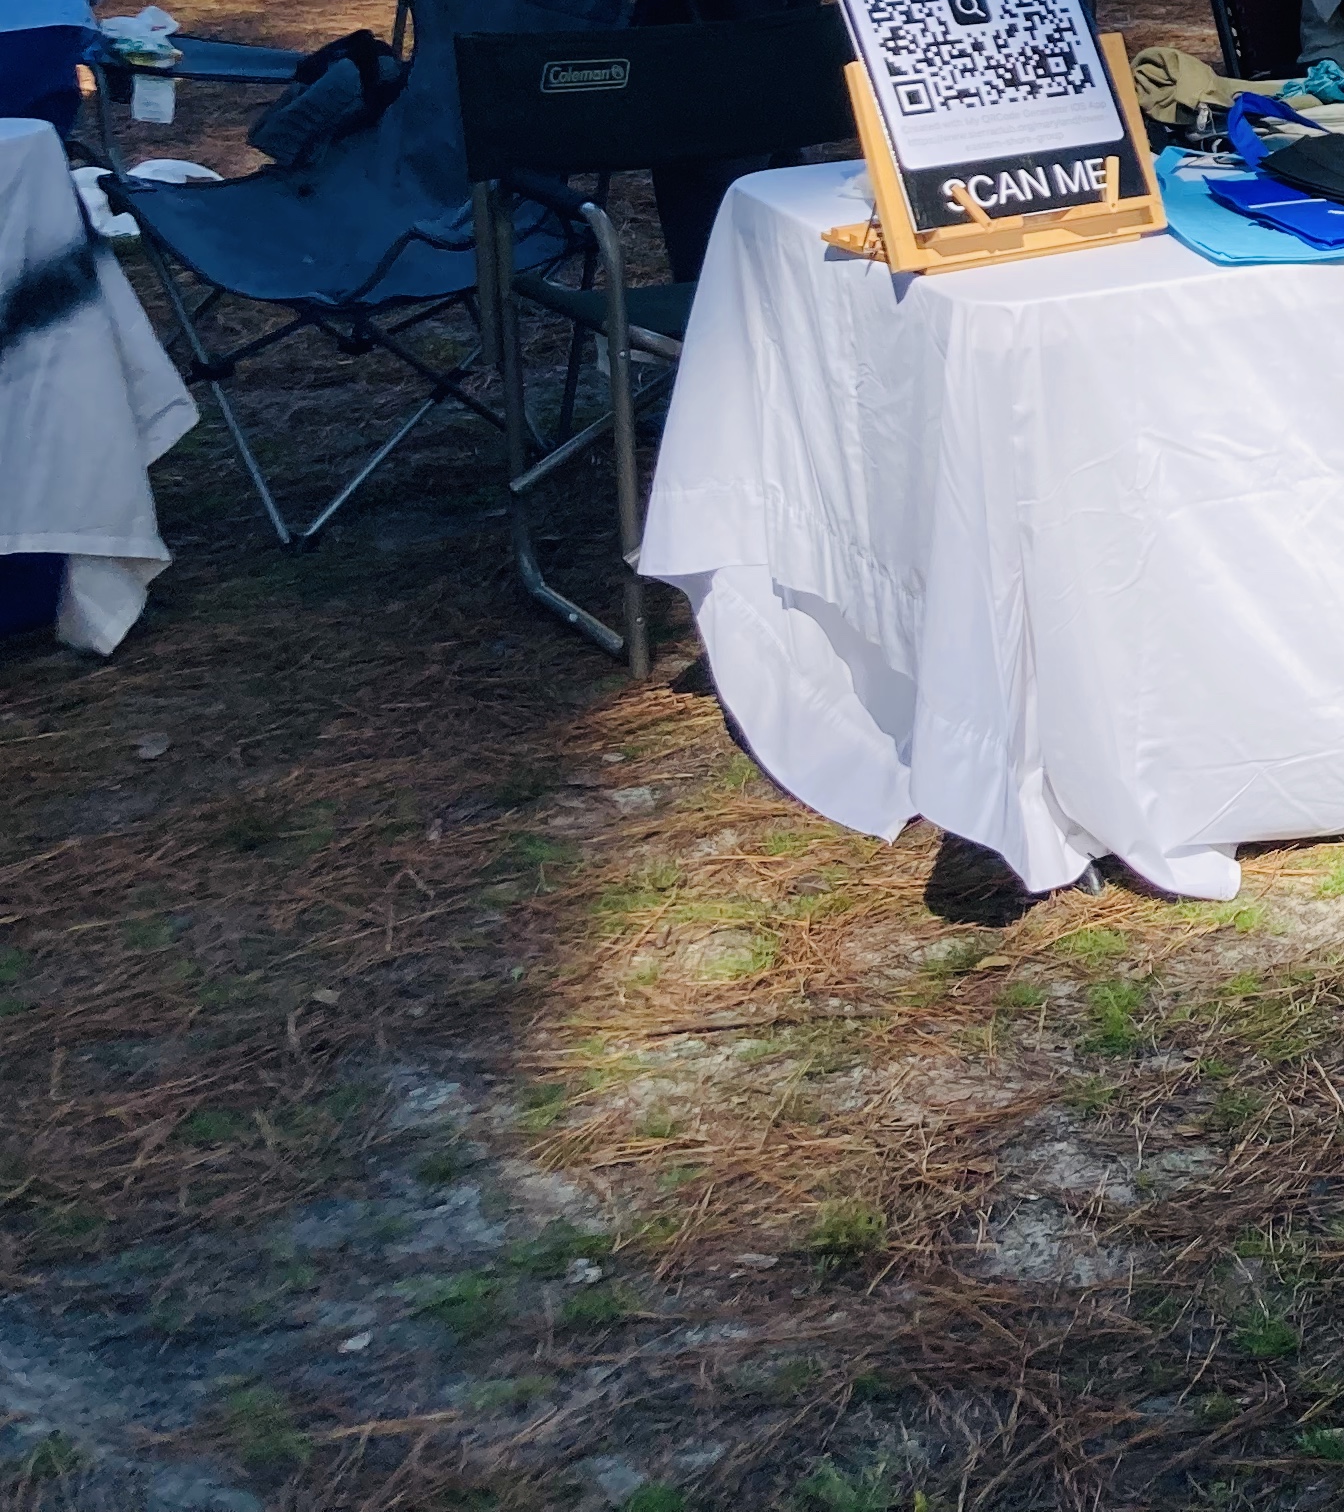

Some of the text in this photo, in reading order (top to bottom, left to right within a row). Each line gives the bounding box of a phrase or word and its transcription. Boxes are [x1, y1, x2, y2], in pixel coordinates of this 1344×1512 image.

[549, 65, 610, 85] Coleman
[941, 157, 1108, 213] SCAN ME
